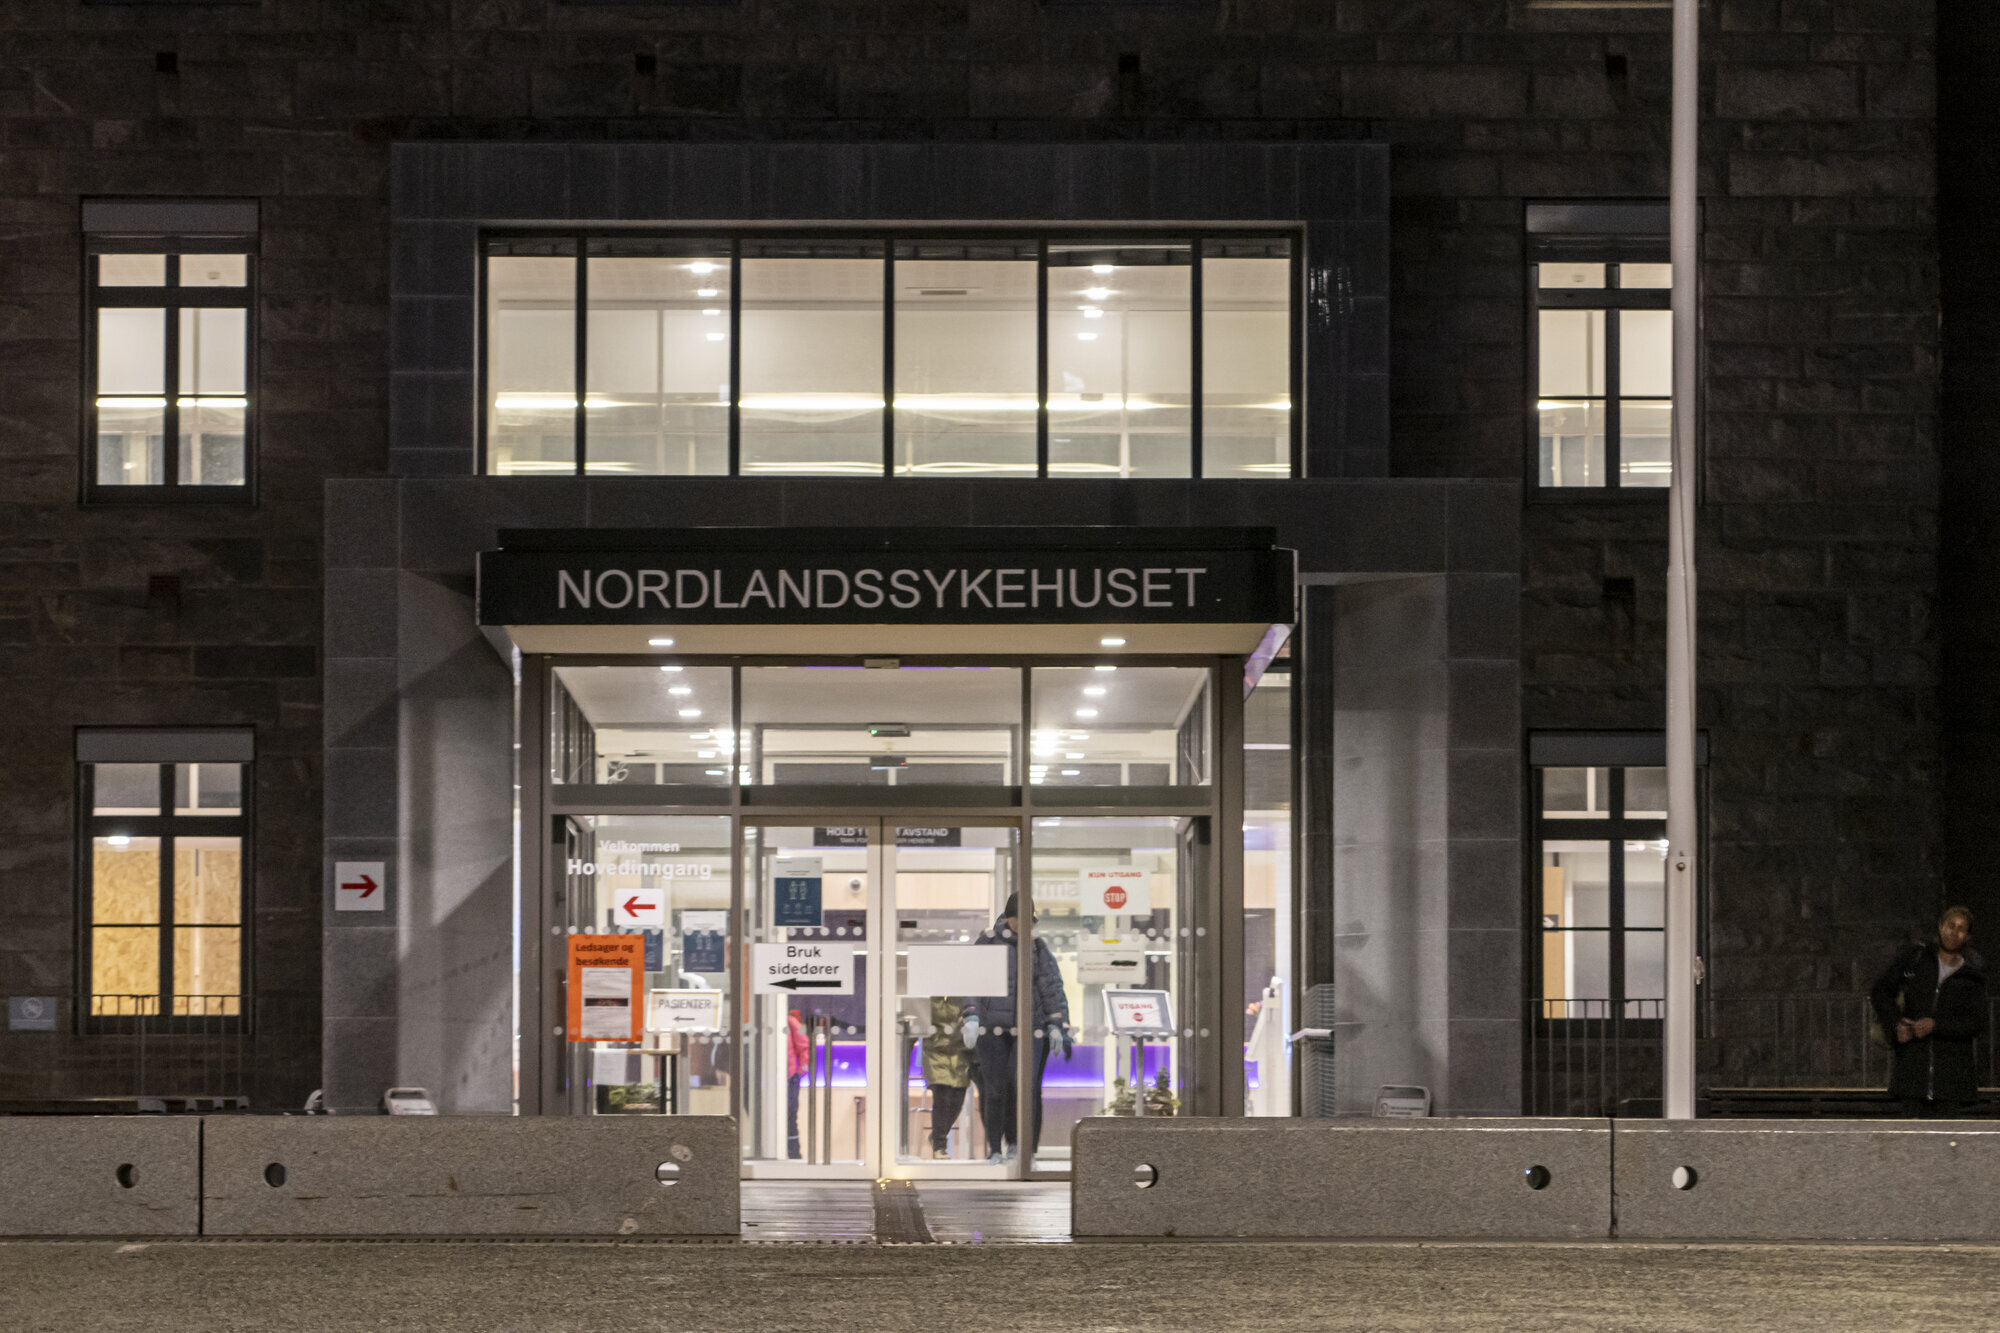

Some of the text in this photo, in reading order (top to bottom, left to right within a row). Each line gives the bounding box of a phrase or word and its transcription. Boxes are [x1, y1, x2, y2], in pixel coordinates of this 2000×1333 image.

[558, 568, 1207, 609] NORDLANDSSYKEHUSET
[826, 826, 855, 836] HOLD
[902, 827, 949, 837] AVSTAND
[600, 840, 680, 852] Velkommen
[567, 858, 712, 880] Hovedinngang
[1104, 893, 1126, 903] STOP
[575, 943, 634, 954] Ledsager og
[786, 945, 822, 958] Bruk
[575, 957, 629, 966] besøkende
[769, 963, 840, 975] sidedører
[658, 999, 712, 1009] PASIENTER
